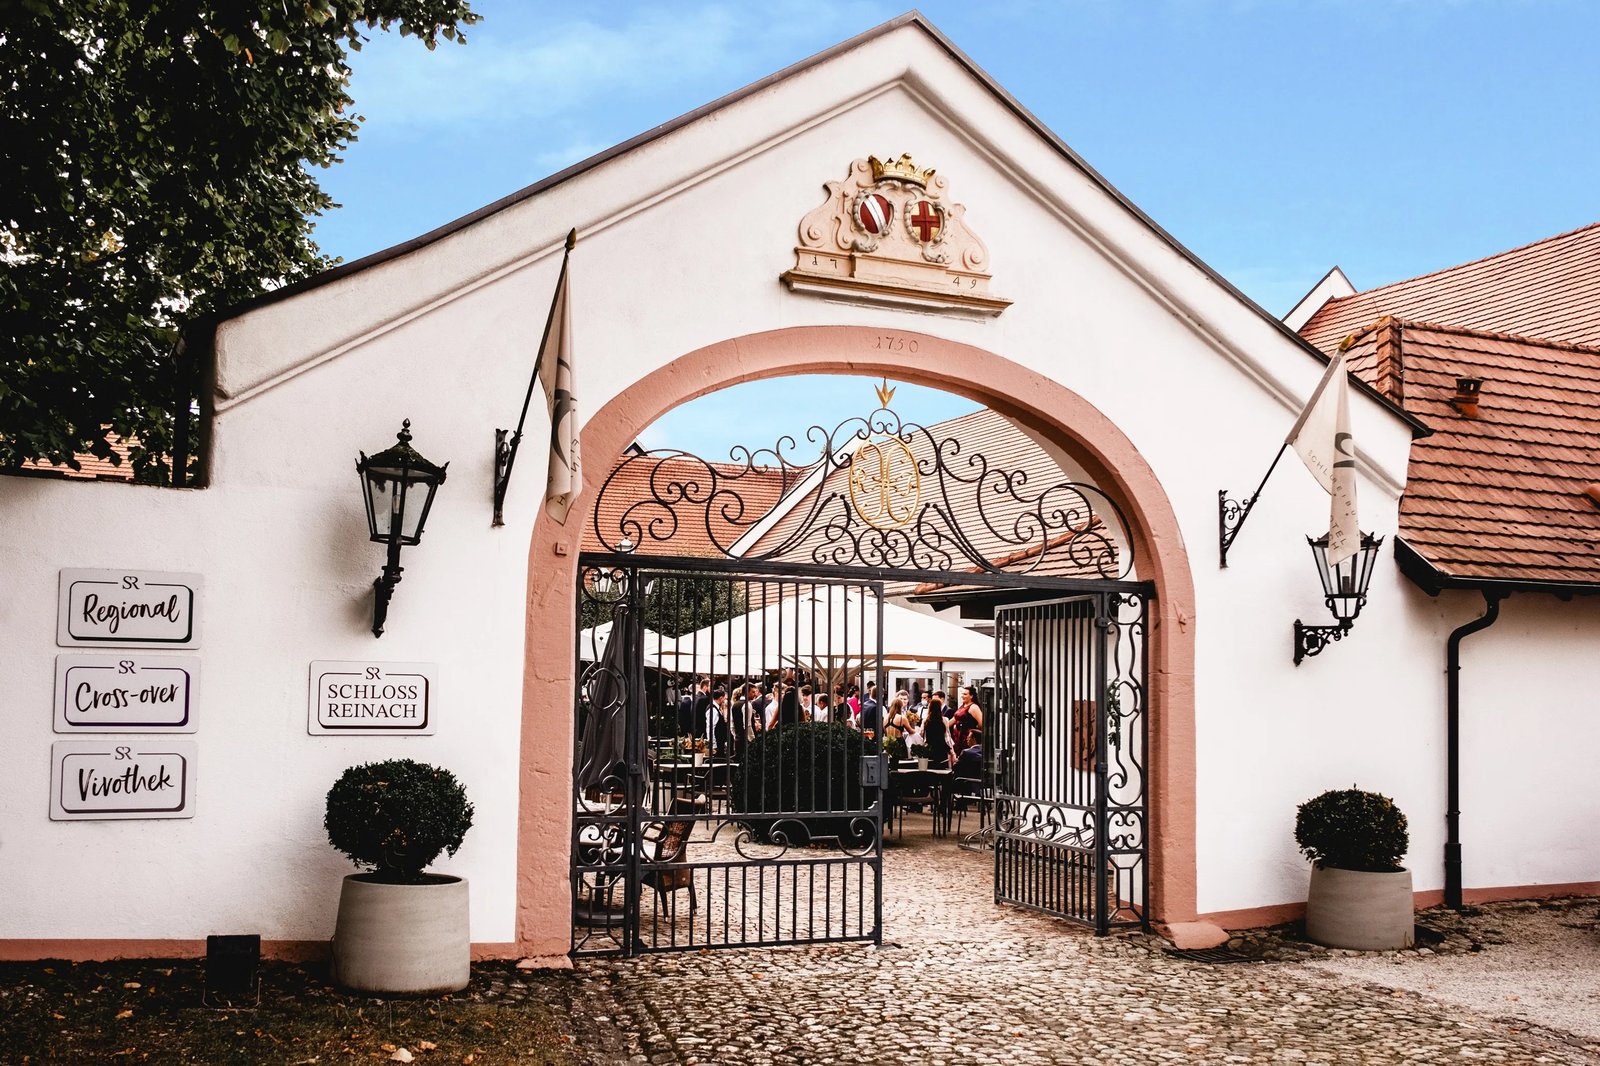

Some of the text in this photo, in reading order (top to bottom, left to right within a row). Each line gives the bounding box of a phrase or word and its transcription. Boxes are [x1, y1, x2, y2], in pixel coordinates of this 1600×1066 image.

[871, 336, 919, 353] 1750
[83, 593, 181, 634] Regional
[75, 682, 180, 713] Cross-over
[327, 683, 418, 700] SCHLOSS
[327, 703, 418, 719] REINACH
[78, 764, 175, 802] Vivothek
